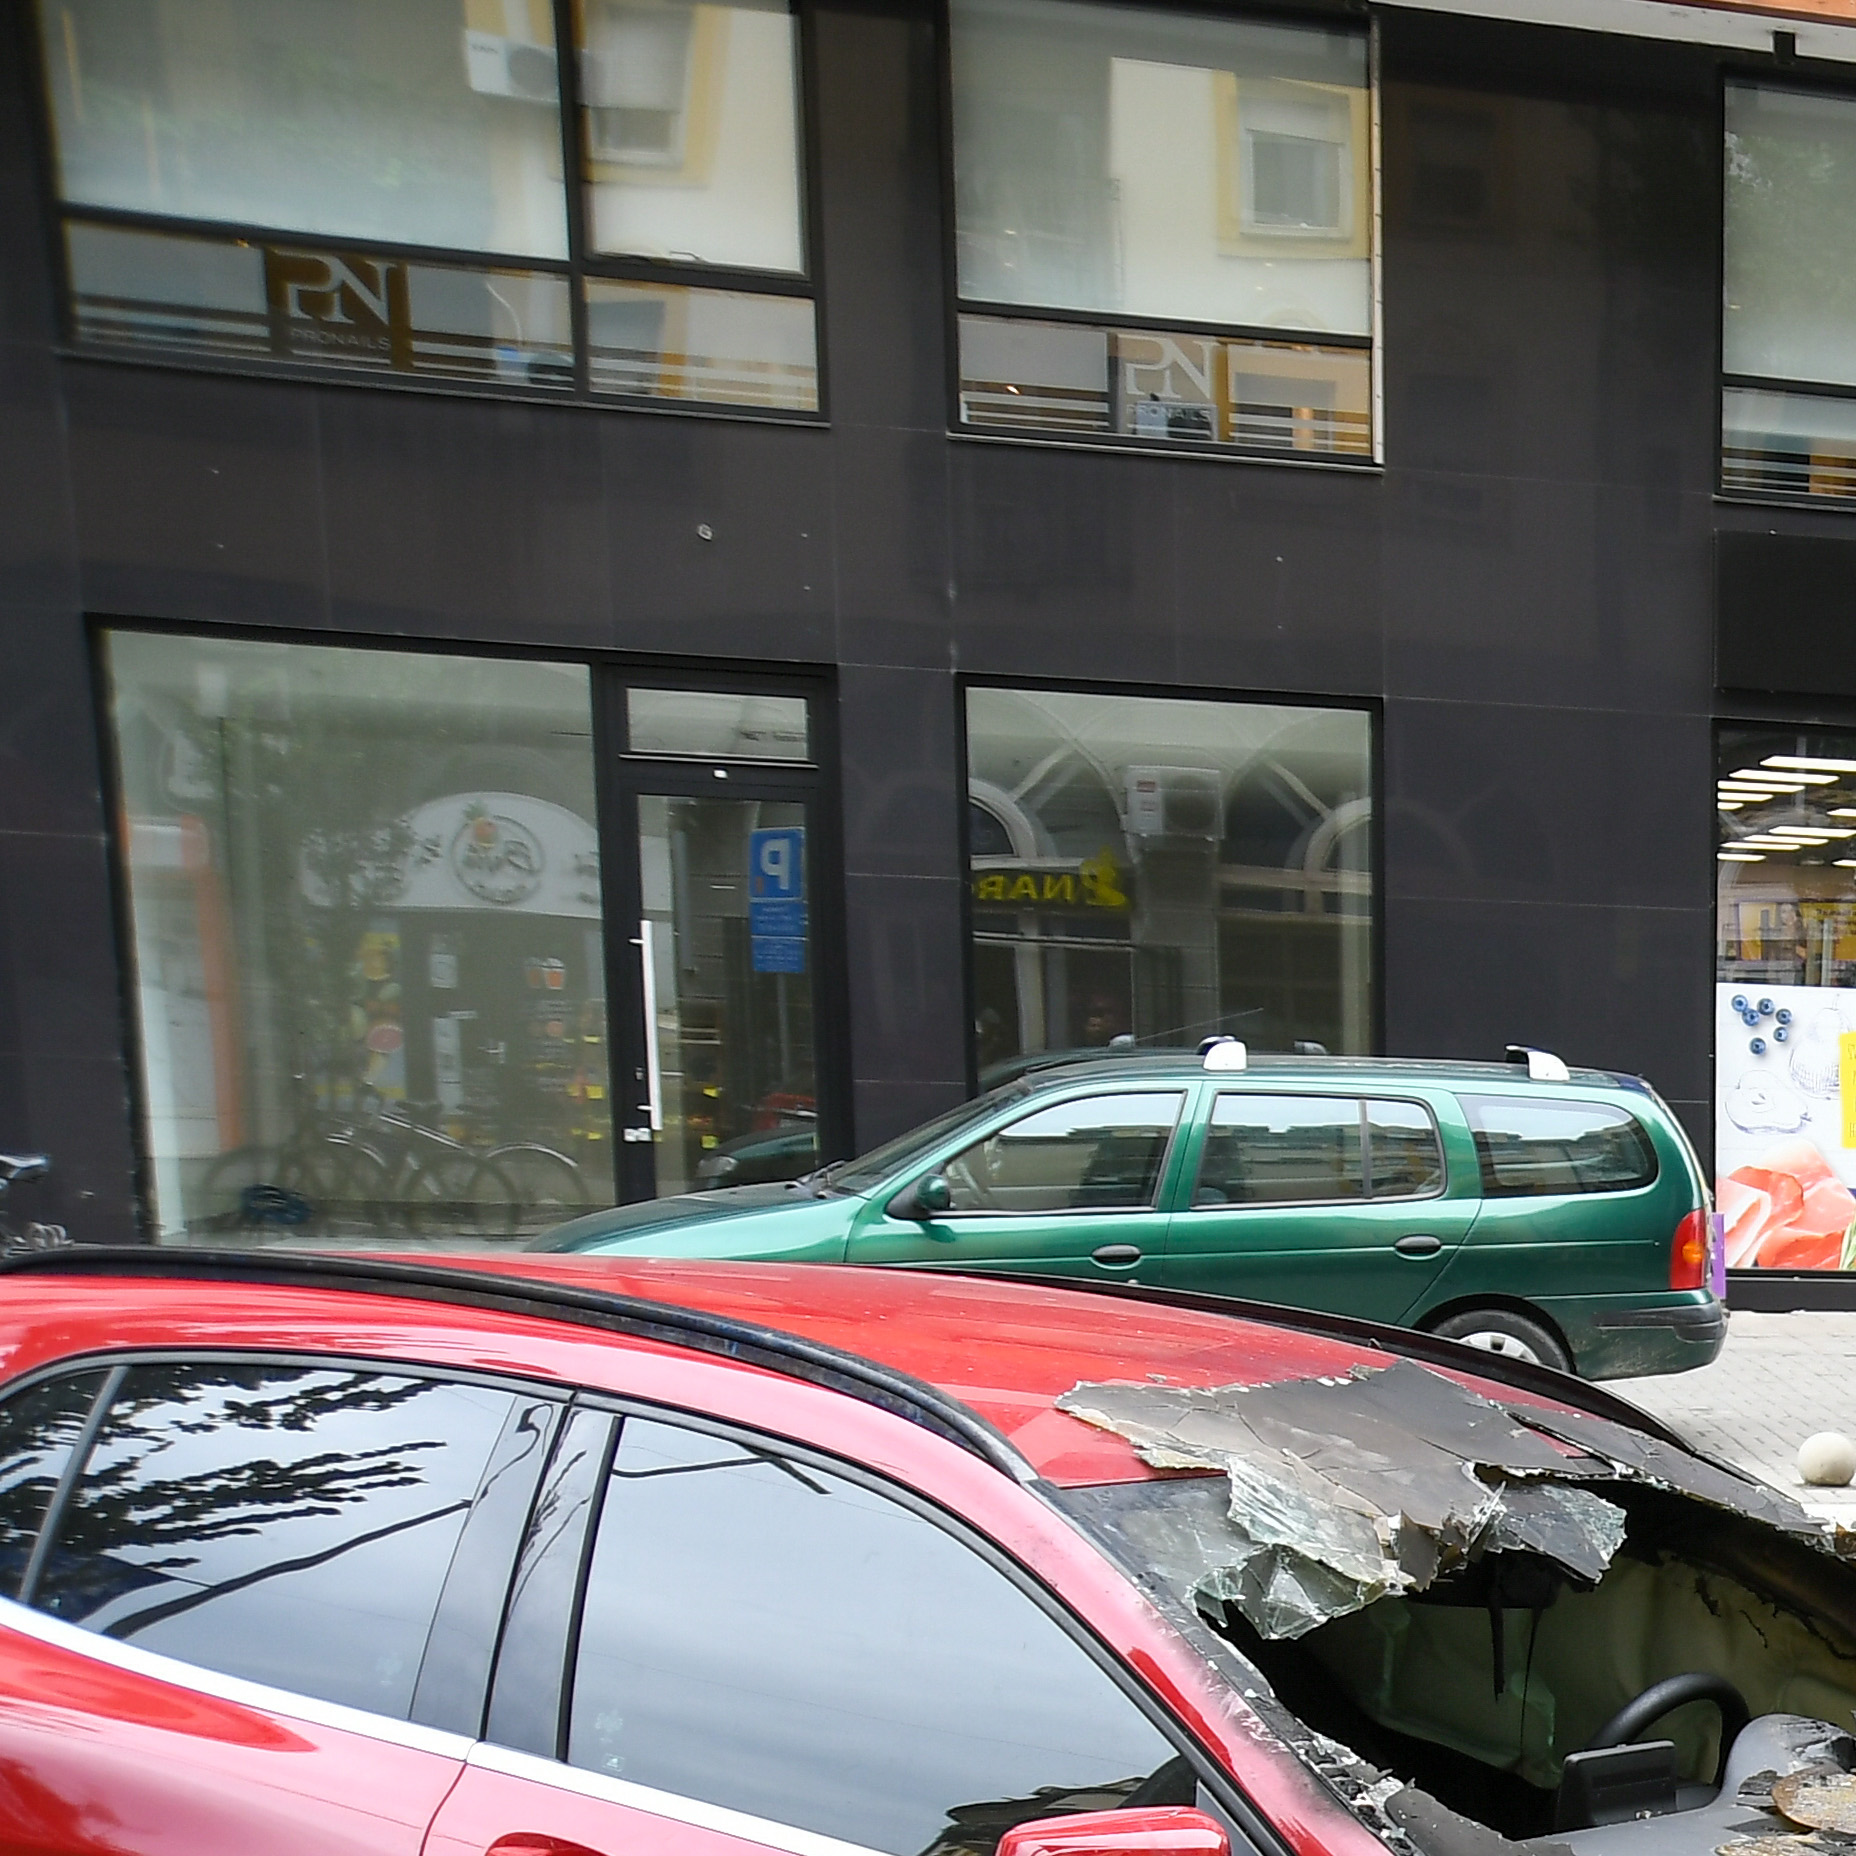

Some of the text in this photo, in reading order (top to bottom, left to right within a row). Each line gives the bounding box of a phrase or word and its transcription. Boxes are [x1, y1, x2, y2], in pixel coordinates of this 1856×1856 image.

[275, 250, 397, 326] PN
[290, 327, 391, 350] PRONAILS
[1117, 334, 1221, 399] PN
[1126, 404, 1211, 422] PRONAILS
